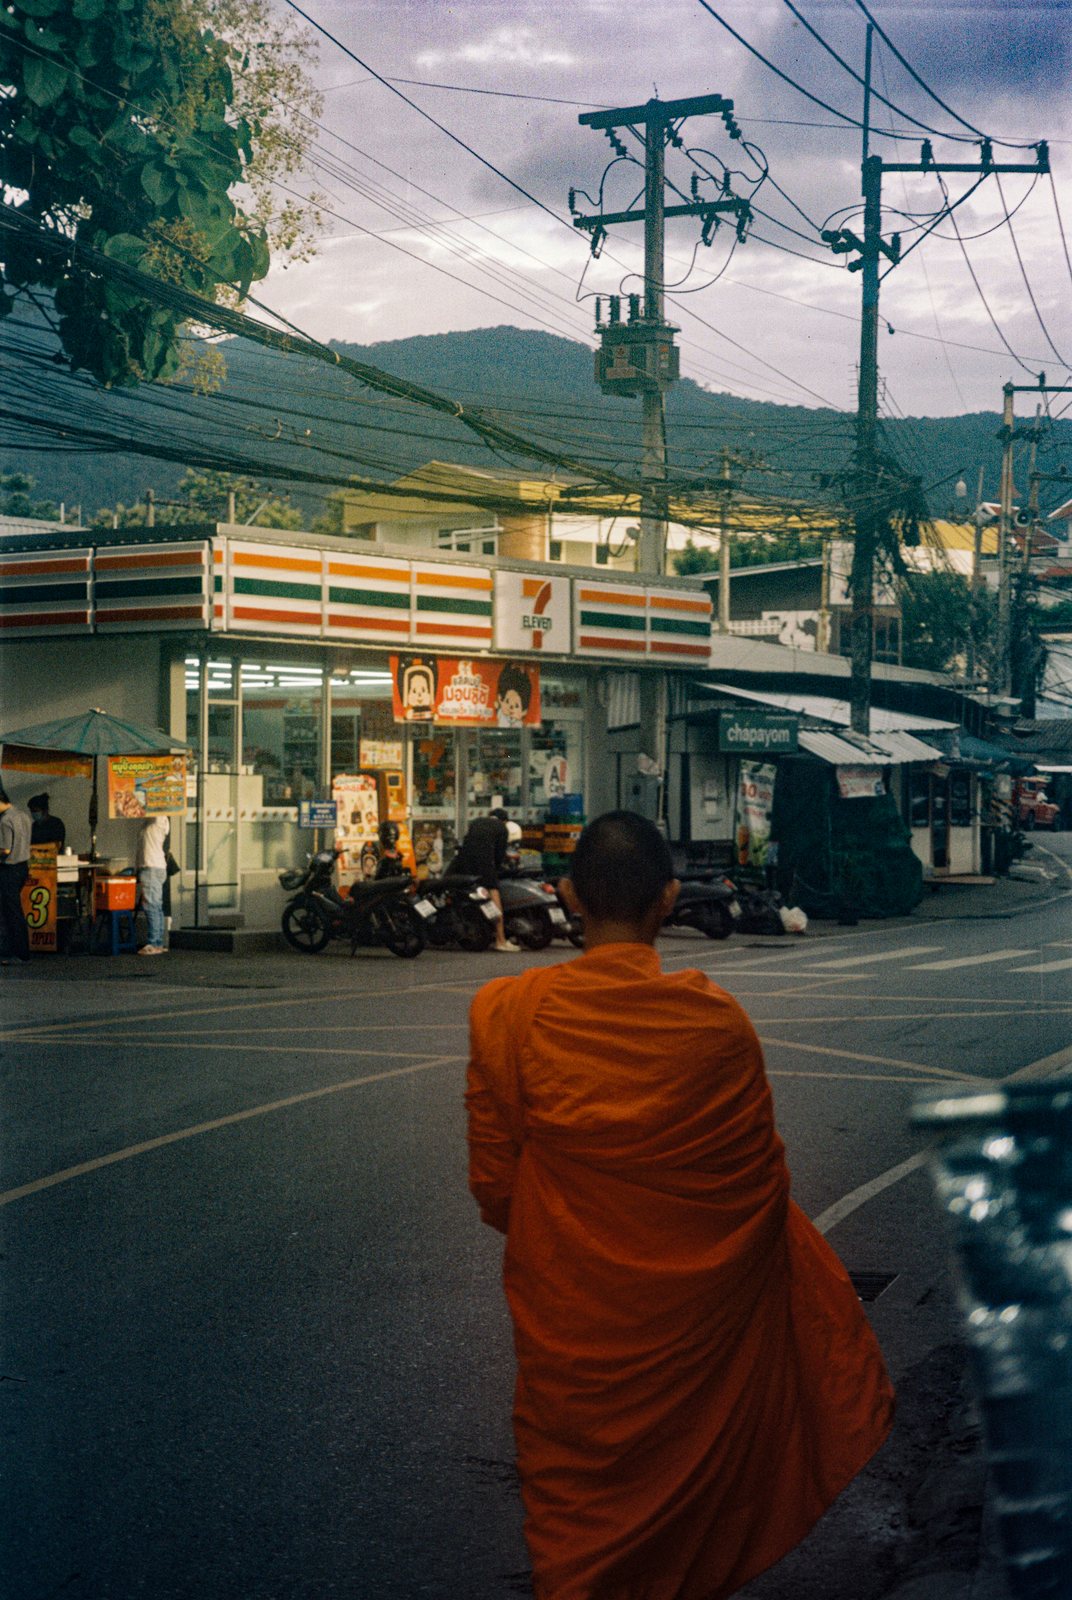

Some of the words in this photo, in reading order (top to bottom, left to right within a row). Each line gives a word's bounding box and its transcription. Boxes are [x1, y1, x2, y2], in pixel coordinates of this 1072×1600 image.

[523, 579, 551, 649] 7
[727, 722, 790, 747] chapayom
[26, 886, 51, 929] 3
